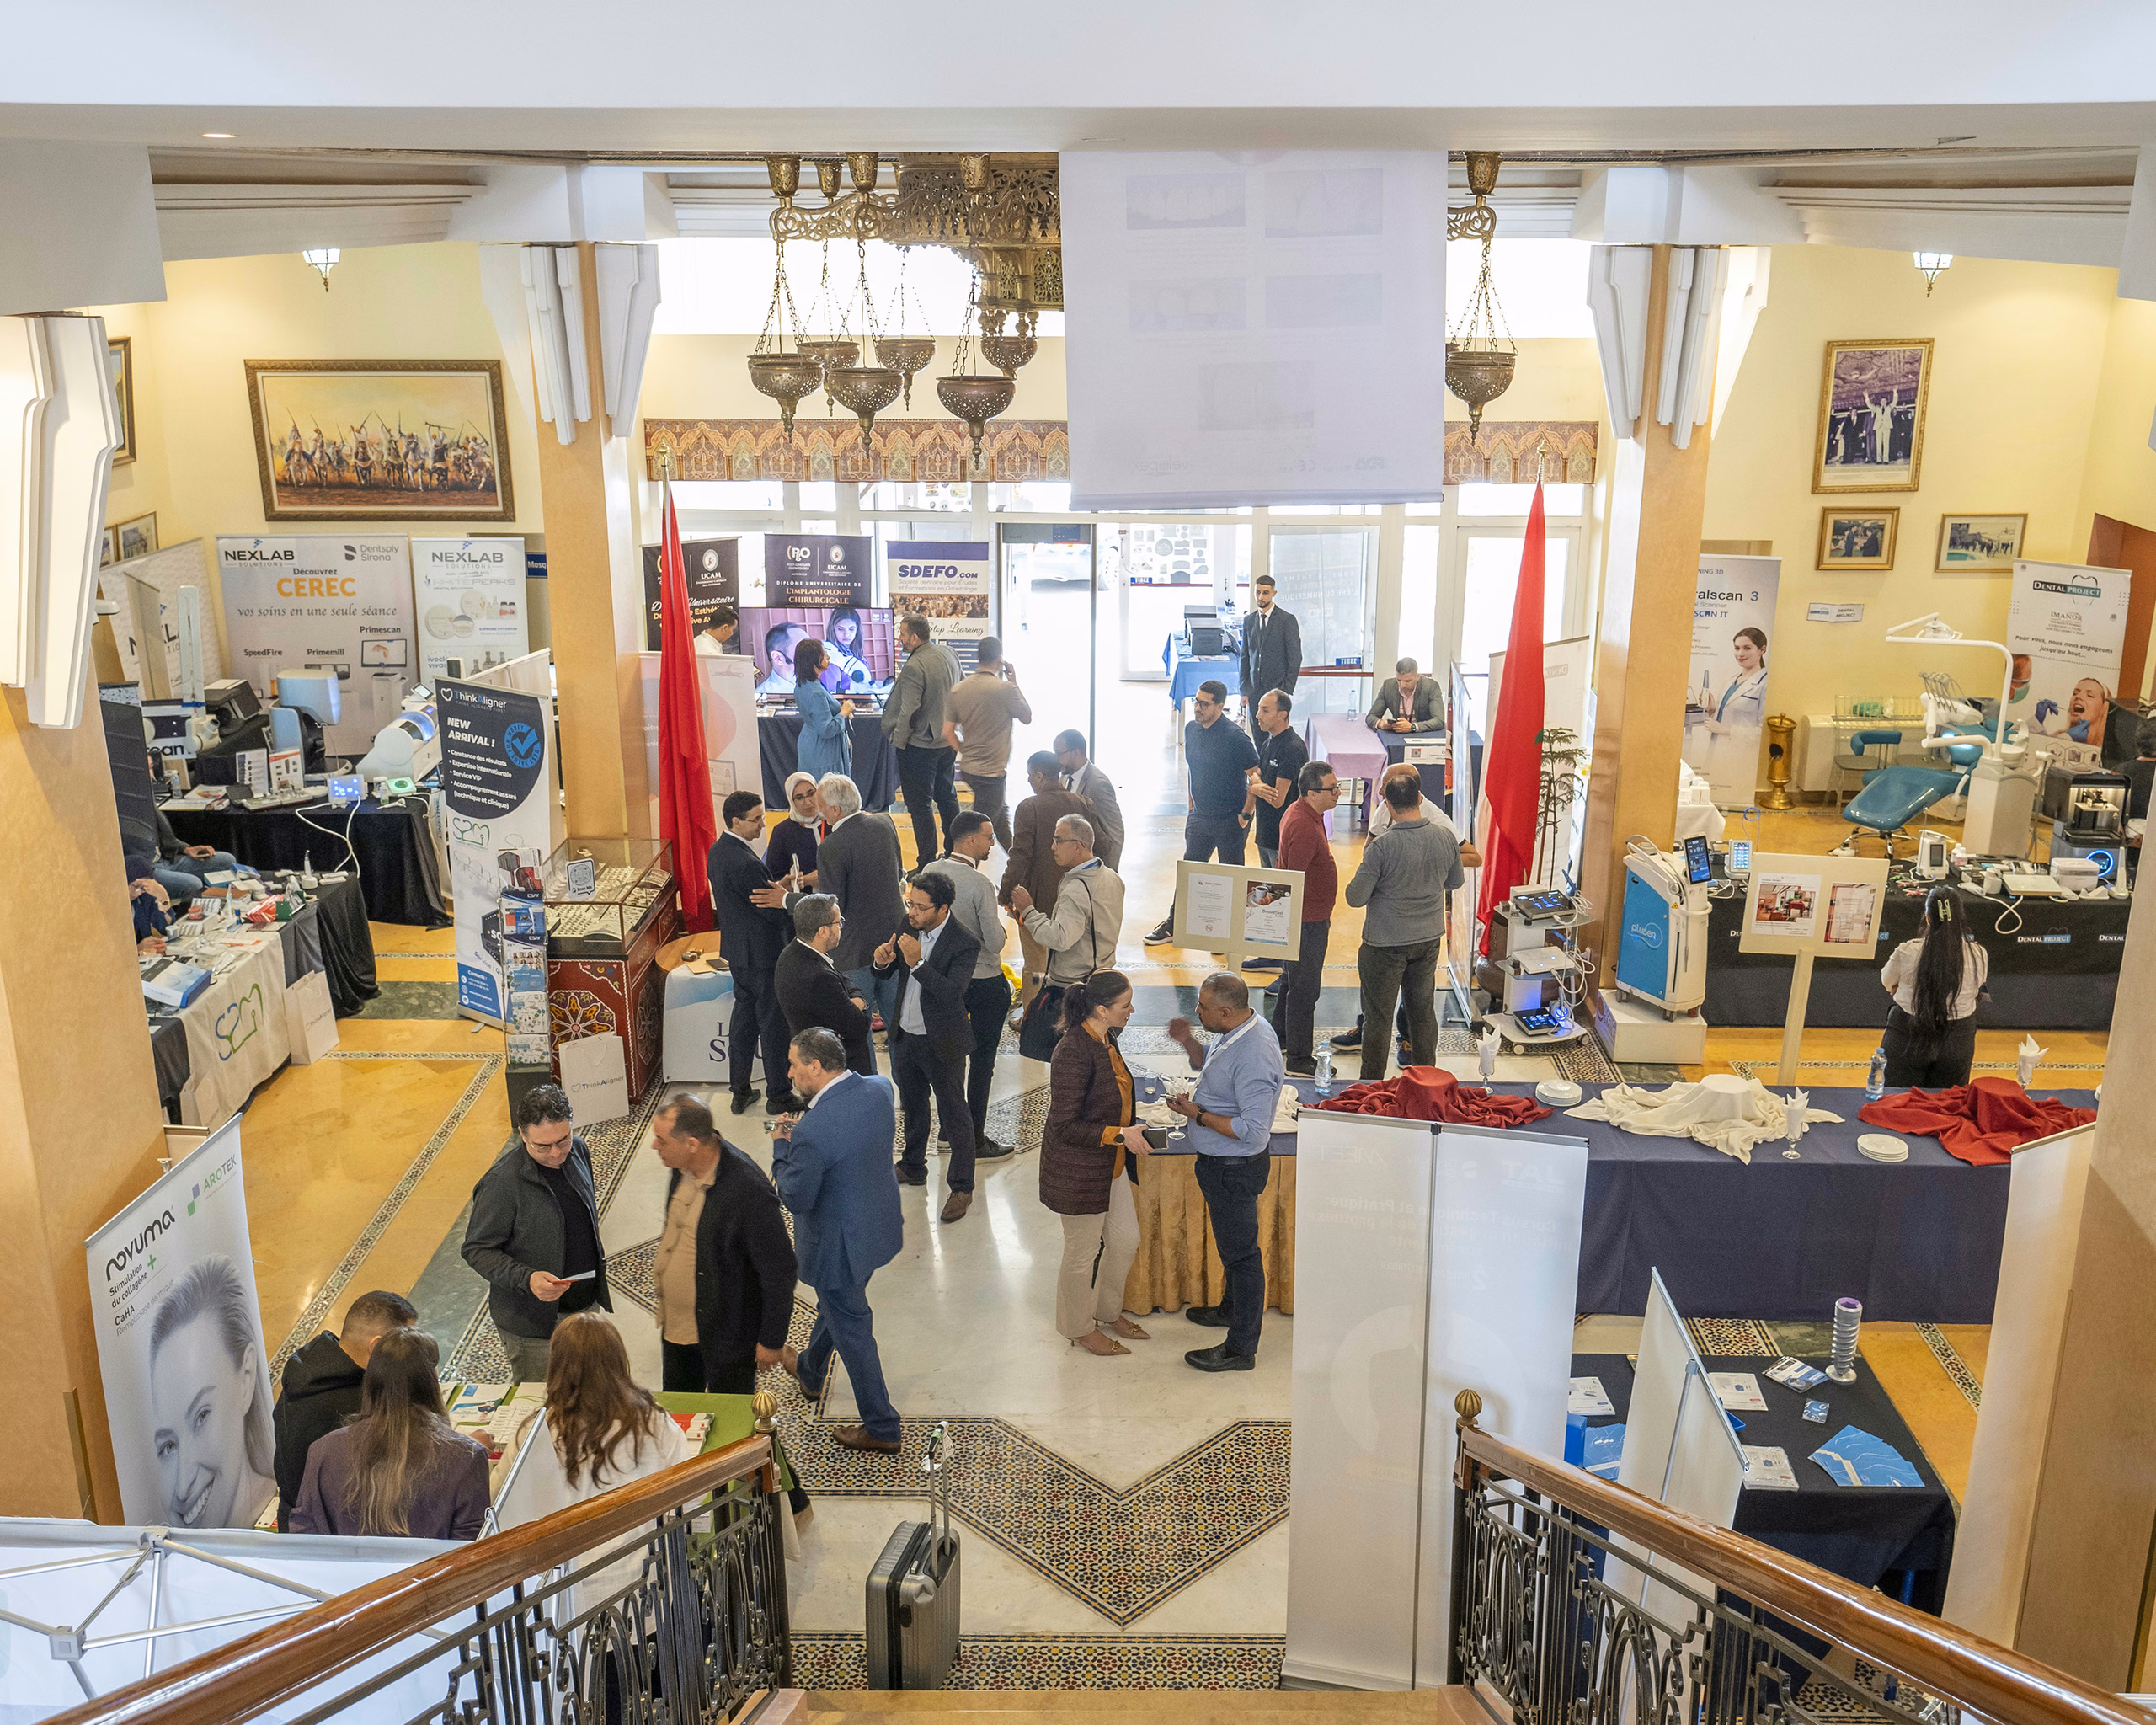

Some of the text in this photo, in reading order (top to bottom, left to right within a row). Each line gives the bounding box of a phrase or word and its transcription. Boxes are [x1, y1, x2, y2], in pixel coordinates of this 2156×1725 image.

[360, 544, 400, 554] Dentsply
[224, 550, 295, 561] NEXLAB
[360, 553, 392, 562] Sirona
[431, 552, 504, 563] NEXLAB
[293, 567, 338, 575] Découvrez
[276, 577, 357, 598] CEREC
[786, 587, 851, 595] L'IMPLANTOLOGIE
[2034, 581, 2100, 596] DENTAL PROJECT
[788, 596, 849, 605] CHIRURGICALE
[1750, 591, 1758, 601] 3
[237, 604, 398, 617] vos soins en une seule séance
[2051, 611, 2083, 622] IMANOR
[947, 622, 984, 635] Learning
[243, 649, 283, 657] SpeedFire
[307, 648, 345, 656] Primemill
[2079, 644, 2113, 654] engageons
[455, 691, 507, 708] ThinkAligner
[446, 717, 471, 729] NEW
[448, 729, 490, 747] ARRIVAL
[451, 750, 476, 760] Constance
[452, 759, 512, 778] Expertise internationale
[453, 770, 472, 780] Service
[454, 780, 517, 801] Accompagnement assuré
[582, 1076, 624, 1090] ThinkAligner
[204, 1154, 237, 1192] AROTEK
[106, 1210, 175, 1282] novuma
[109, 1263, 143, 1297] Stimulation
[111, 1271, 147, 1308] du collagène
[115, 1304, 135, 1326] CaHA
[116, 1302, 150, 1337] Remplissage
